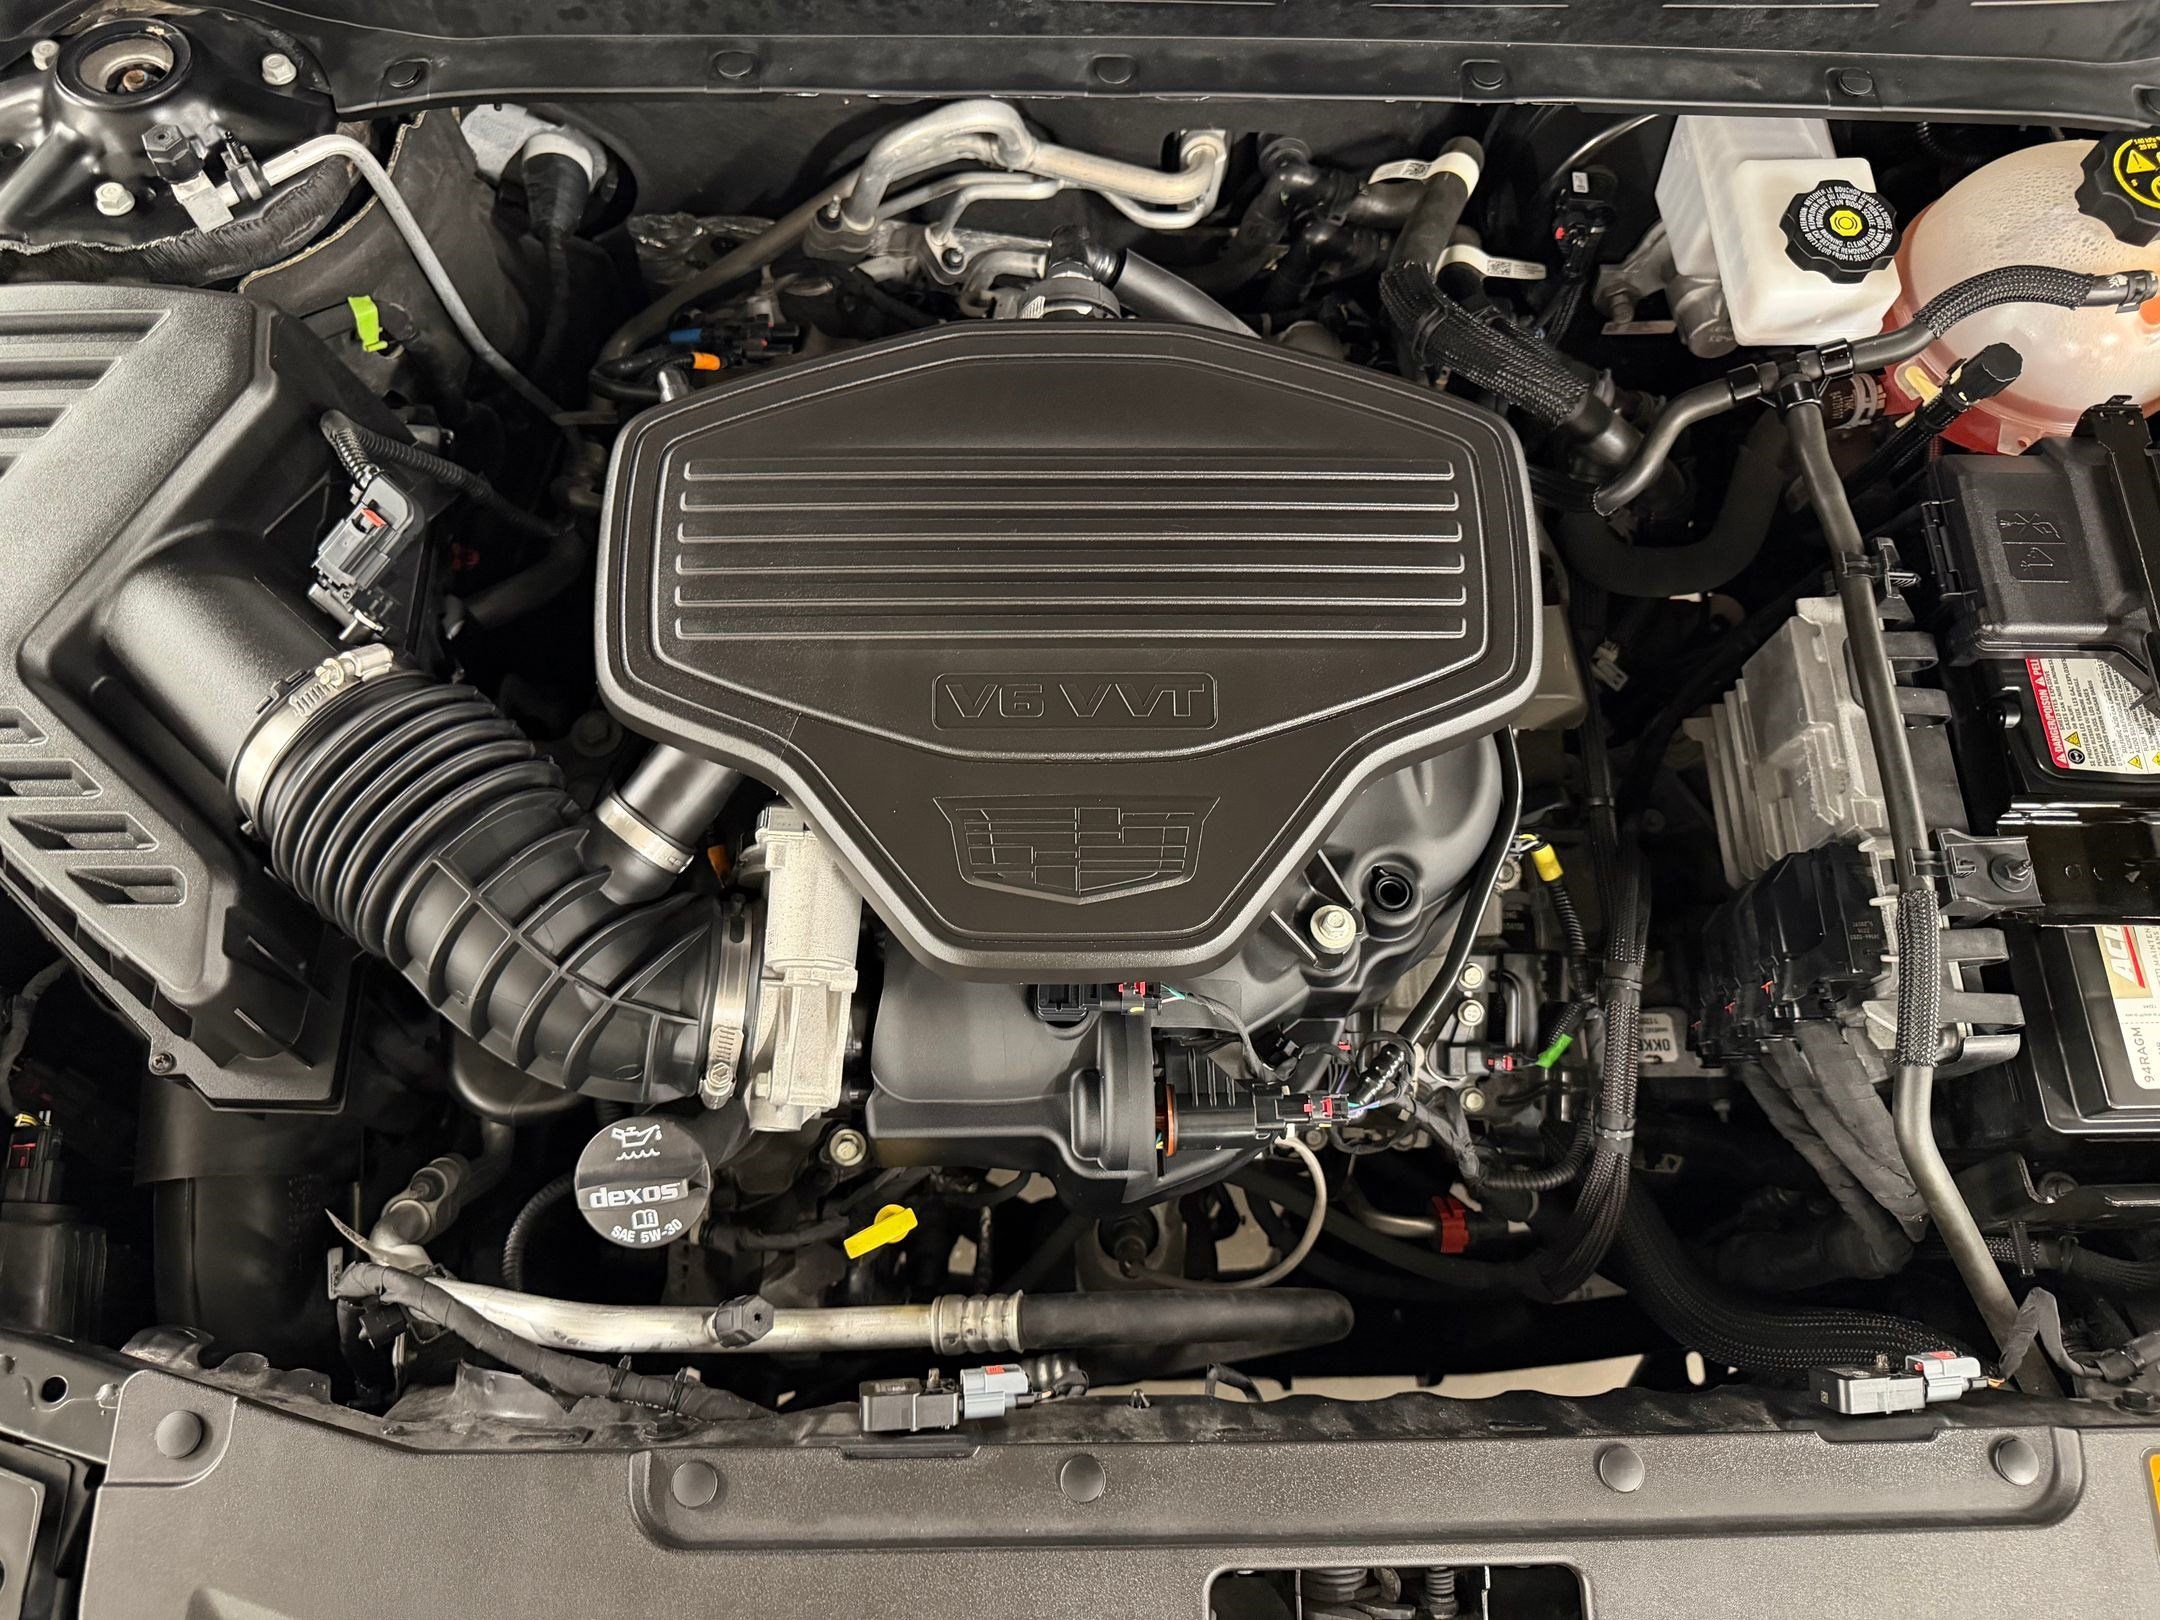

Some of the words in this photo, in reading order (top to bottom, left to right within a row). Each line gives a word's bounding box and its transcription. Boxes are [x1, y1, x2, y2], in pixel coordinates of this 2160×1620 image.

[1816, 195, 1829, 205] QUE
[1826, 193, 1836, 202] DU
[1836, 192, 1859, 202] LIQUIDE
[1857, 196, 1869, 206] DE
[1865, 201, 1883, 217] FREIN
[1825, 186, 1834, 195] LE
[1833, 185, 1863, 196] BOUCHON
[1861, 190, 1879, 206] AVANT
[1875, 204, 1885, 212] LA
[1829, 198, 1844, 207] D'UN
[1844, 199, 1864, 211] BIDON
[1810, 229, 1823, 242] CAP
[1817, 237, 1841, 253] BEFORE
[1866, 239, 1880, 250] USE
[1814, 242, 1832, 256] FLUID
[1831, 251, 1849, 261] FROM
[1848, 254, 1854, 262] A
[1853, 250, 1875, 262] SEALED
[1846, 239, 1866, 248] CLEAN
[944, 683, 1046, 719] V6
[1059, 682, 1206, 718] VVT
[2038, 689, 2064, 753] DANGER/POISON
[2130, 1026, 2155, 1084] 94RAGM
[589, 1182, 680, 1209] dexos
[610, 1225, 636, 1243] SAE
[640, 1218, 683, 1244] 5W-30
